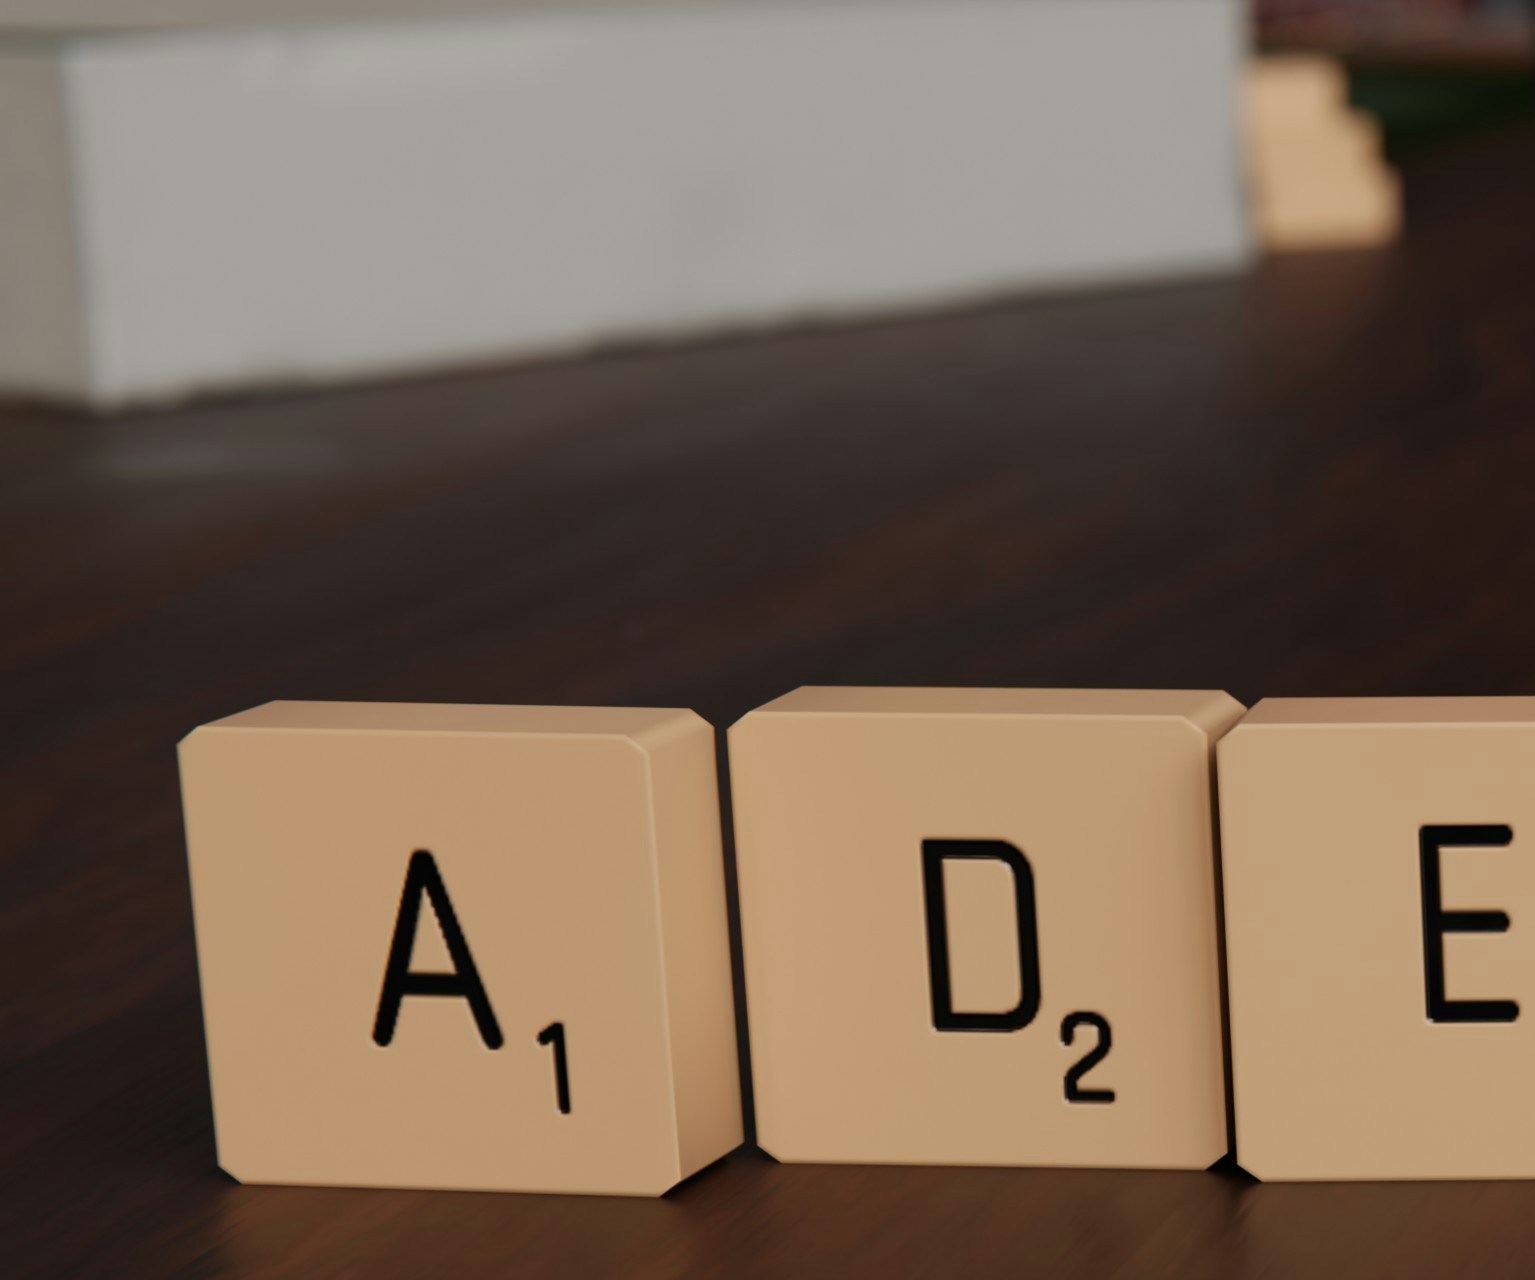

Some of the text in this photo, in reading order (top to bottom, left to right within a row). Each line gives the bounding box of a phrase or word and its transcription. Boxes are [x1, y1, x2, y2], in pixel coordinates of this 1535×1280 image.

[371, 848, 506, 1052] A
[919, 837, 1043, 1035] D
[1417, 822, 1522, 1025] E
